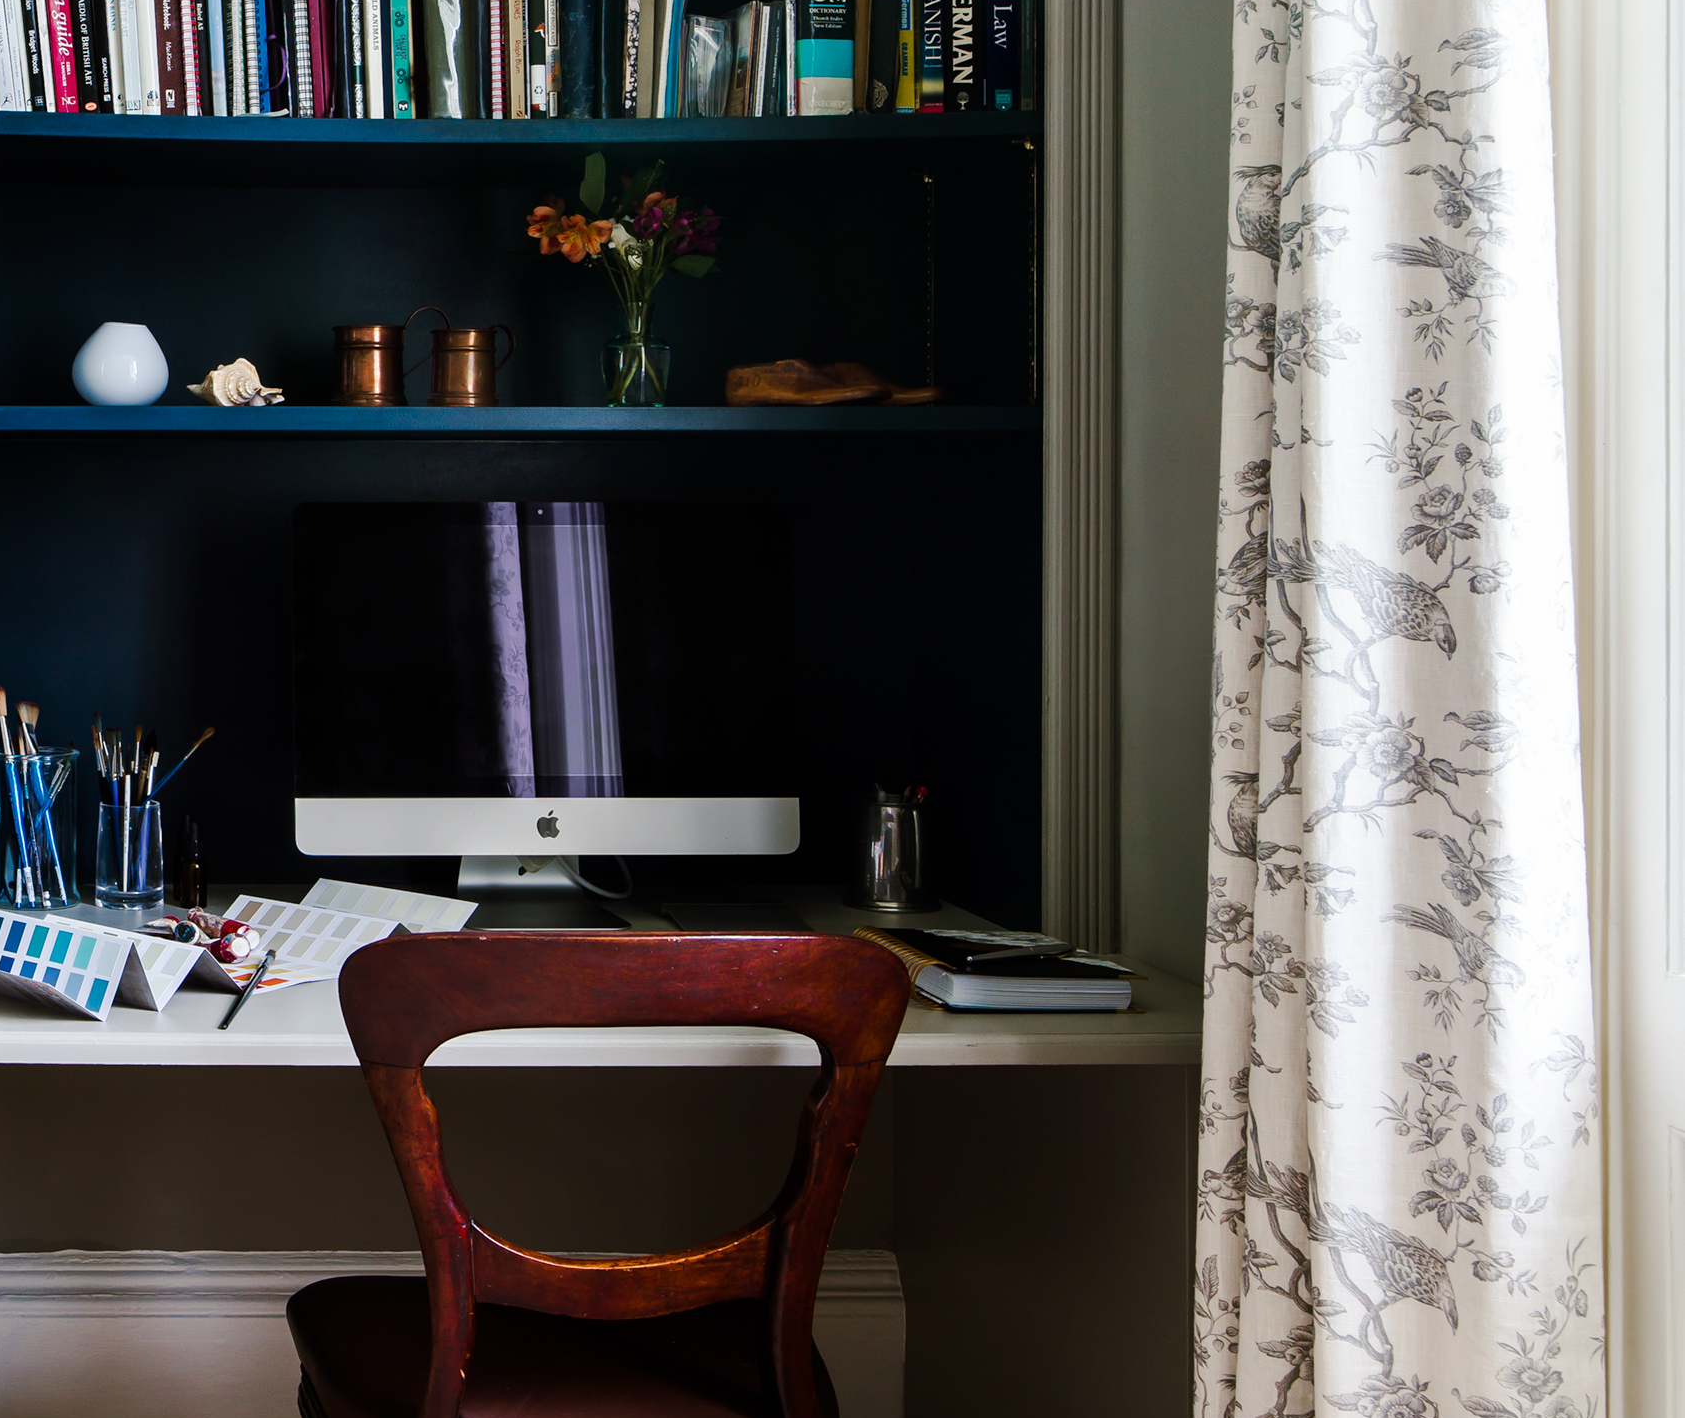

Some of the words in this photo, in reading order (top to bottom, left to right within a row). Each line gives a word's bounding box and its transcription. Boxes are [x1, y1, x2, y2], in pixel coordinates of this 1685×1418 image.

[513, 0, 521, 20] RUNES
[52, 5, 73, 57] guide
[80, 23, 88, 34] OF
[993, 4, 1013, 49] Law
[27, 29, 38, 53] Bridget
[514, 39, 522, 57] Ralph
[80, 36, 92, 68] BRITISH
[31, 54, 40, 74] Woods
[83, 70, 94, 86] ART
